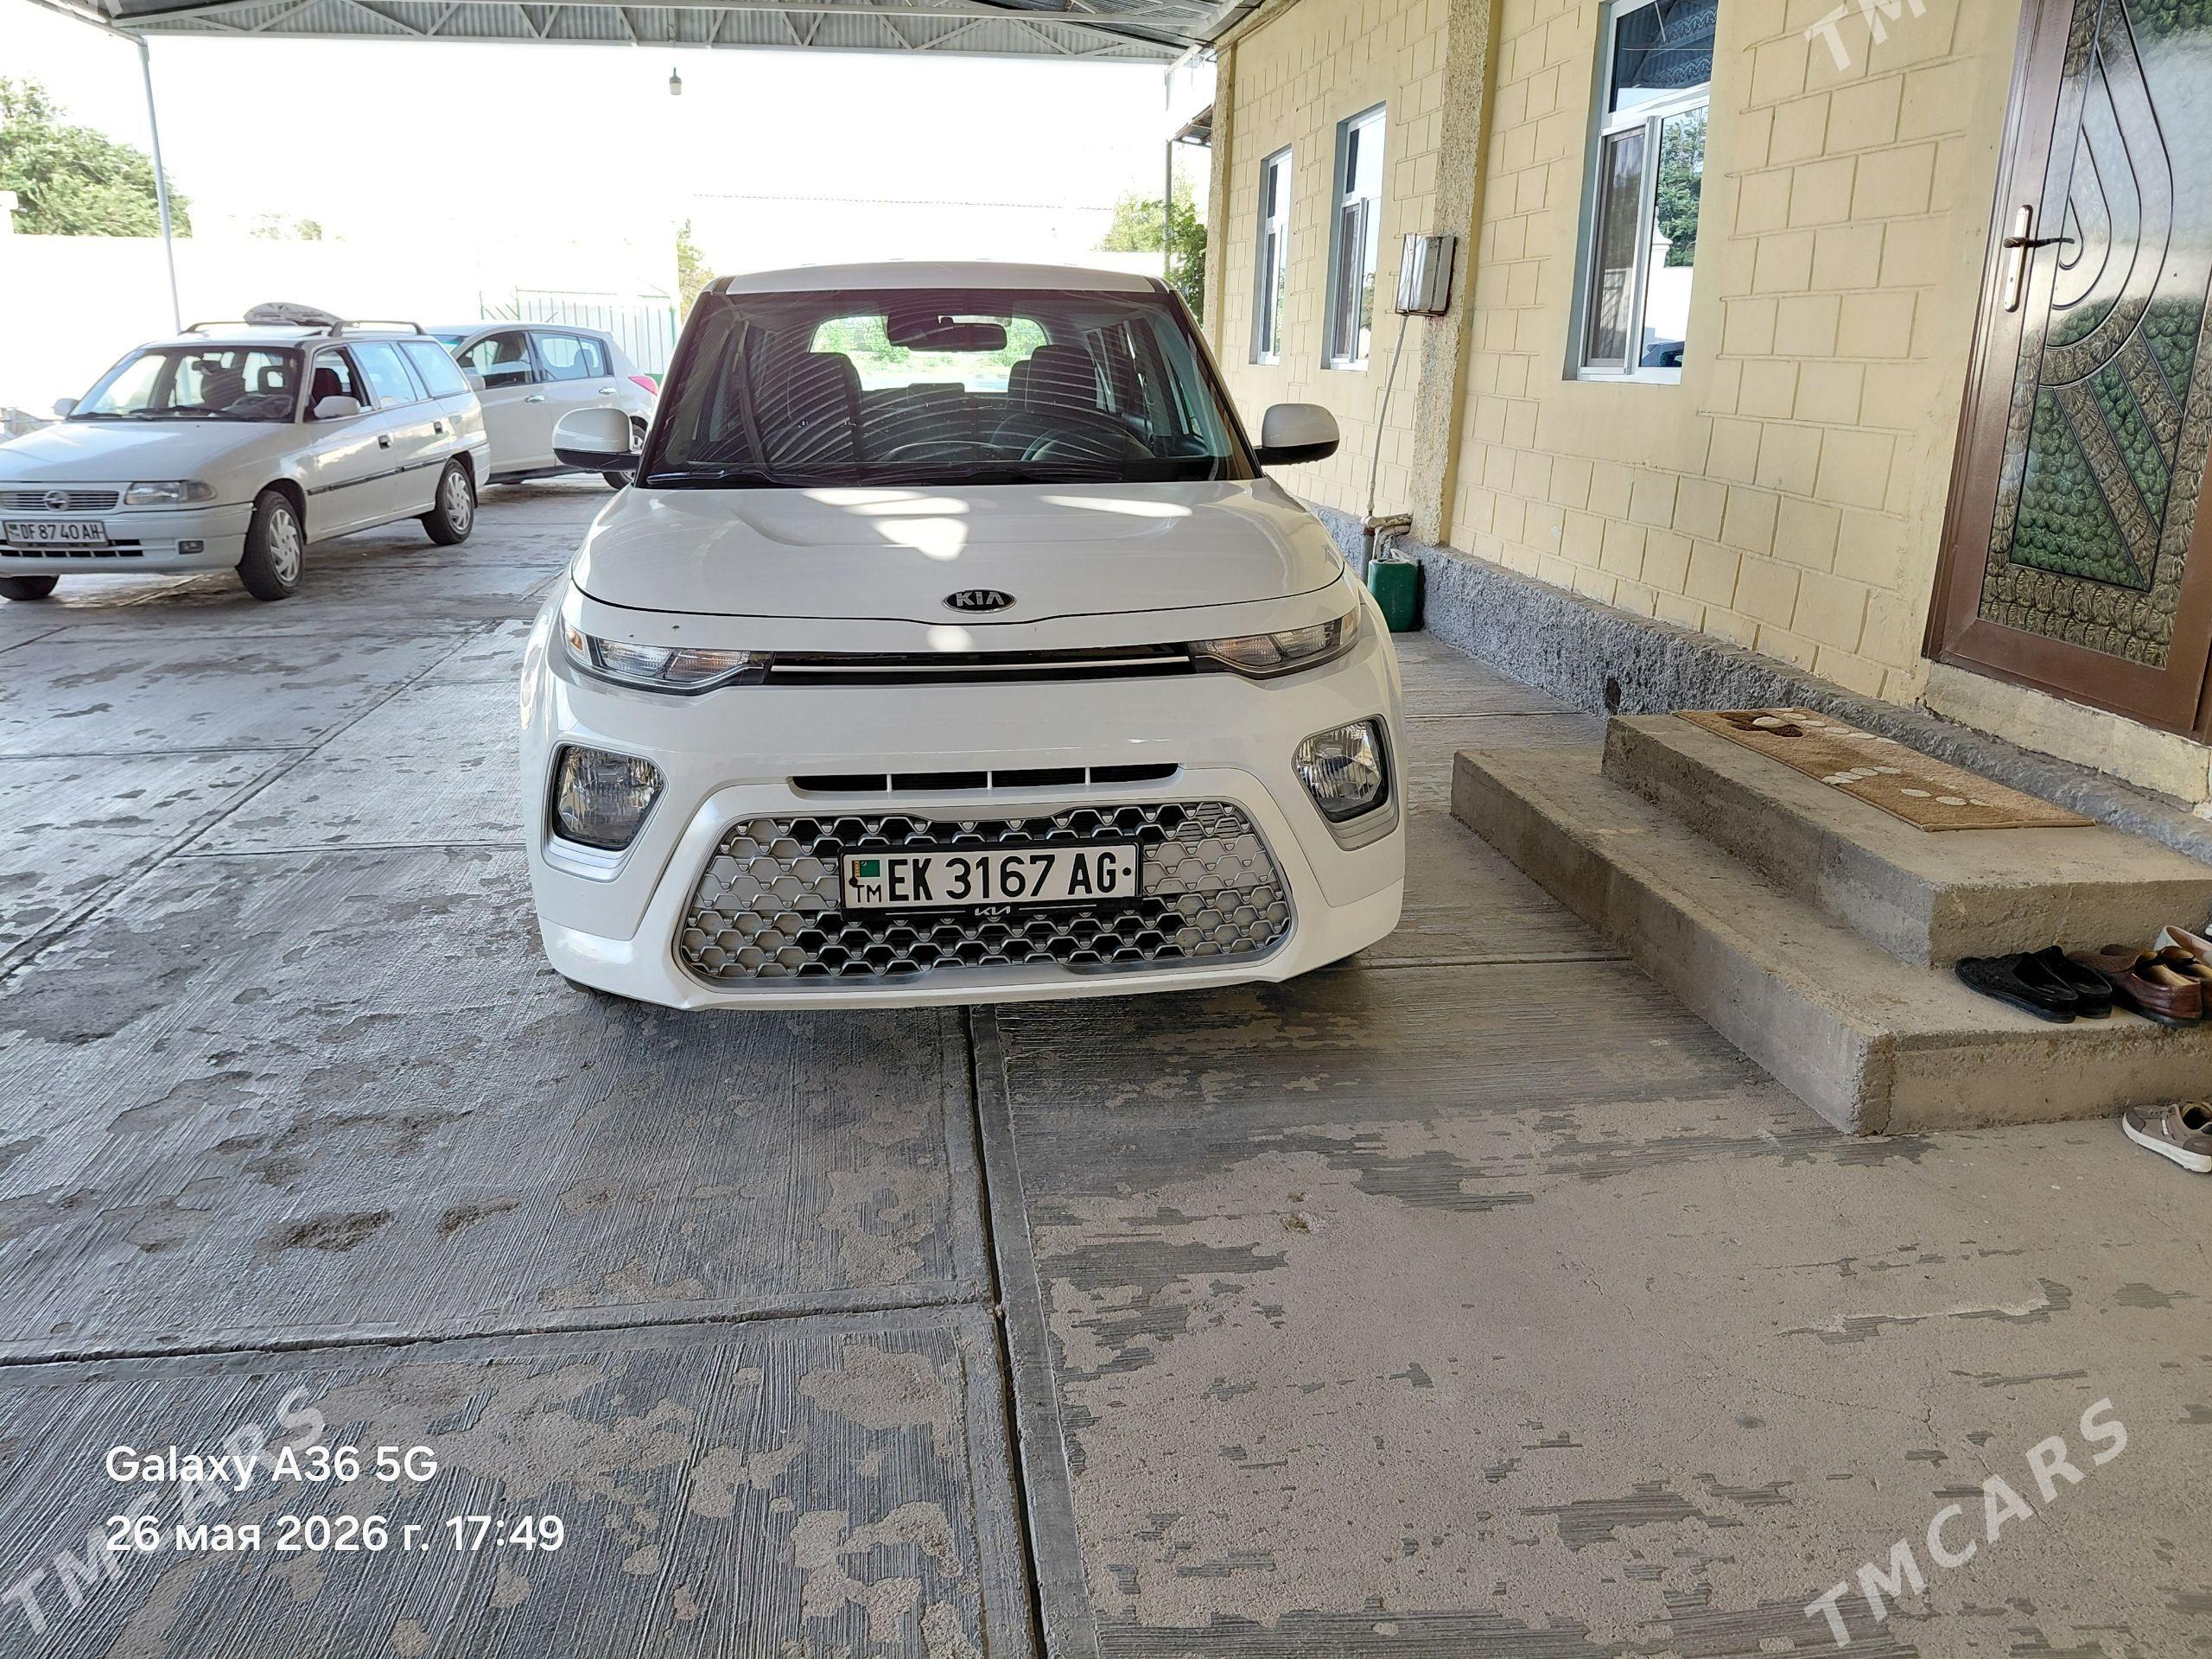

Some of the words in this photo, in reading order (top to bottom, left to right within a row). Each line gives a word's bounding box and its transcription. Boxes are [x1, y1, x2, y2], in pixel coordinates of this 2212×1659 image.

[19, 524, 35, 539] DF
[955, 591, 1005, 607] KIA
[887, 858, 934, 902] EK
[944, 854, 1056, 900] 3167
[1067, 851, 1117, 896] AG
[855, 884, 882, 904] TM
